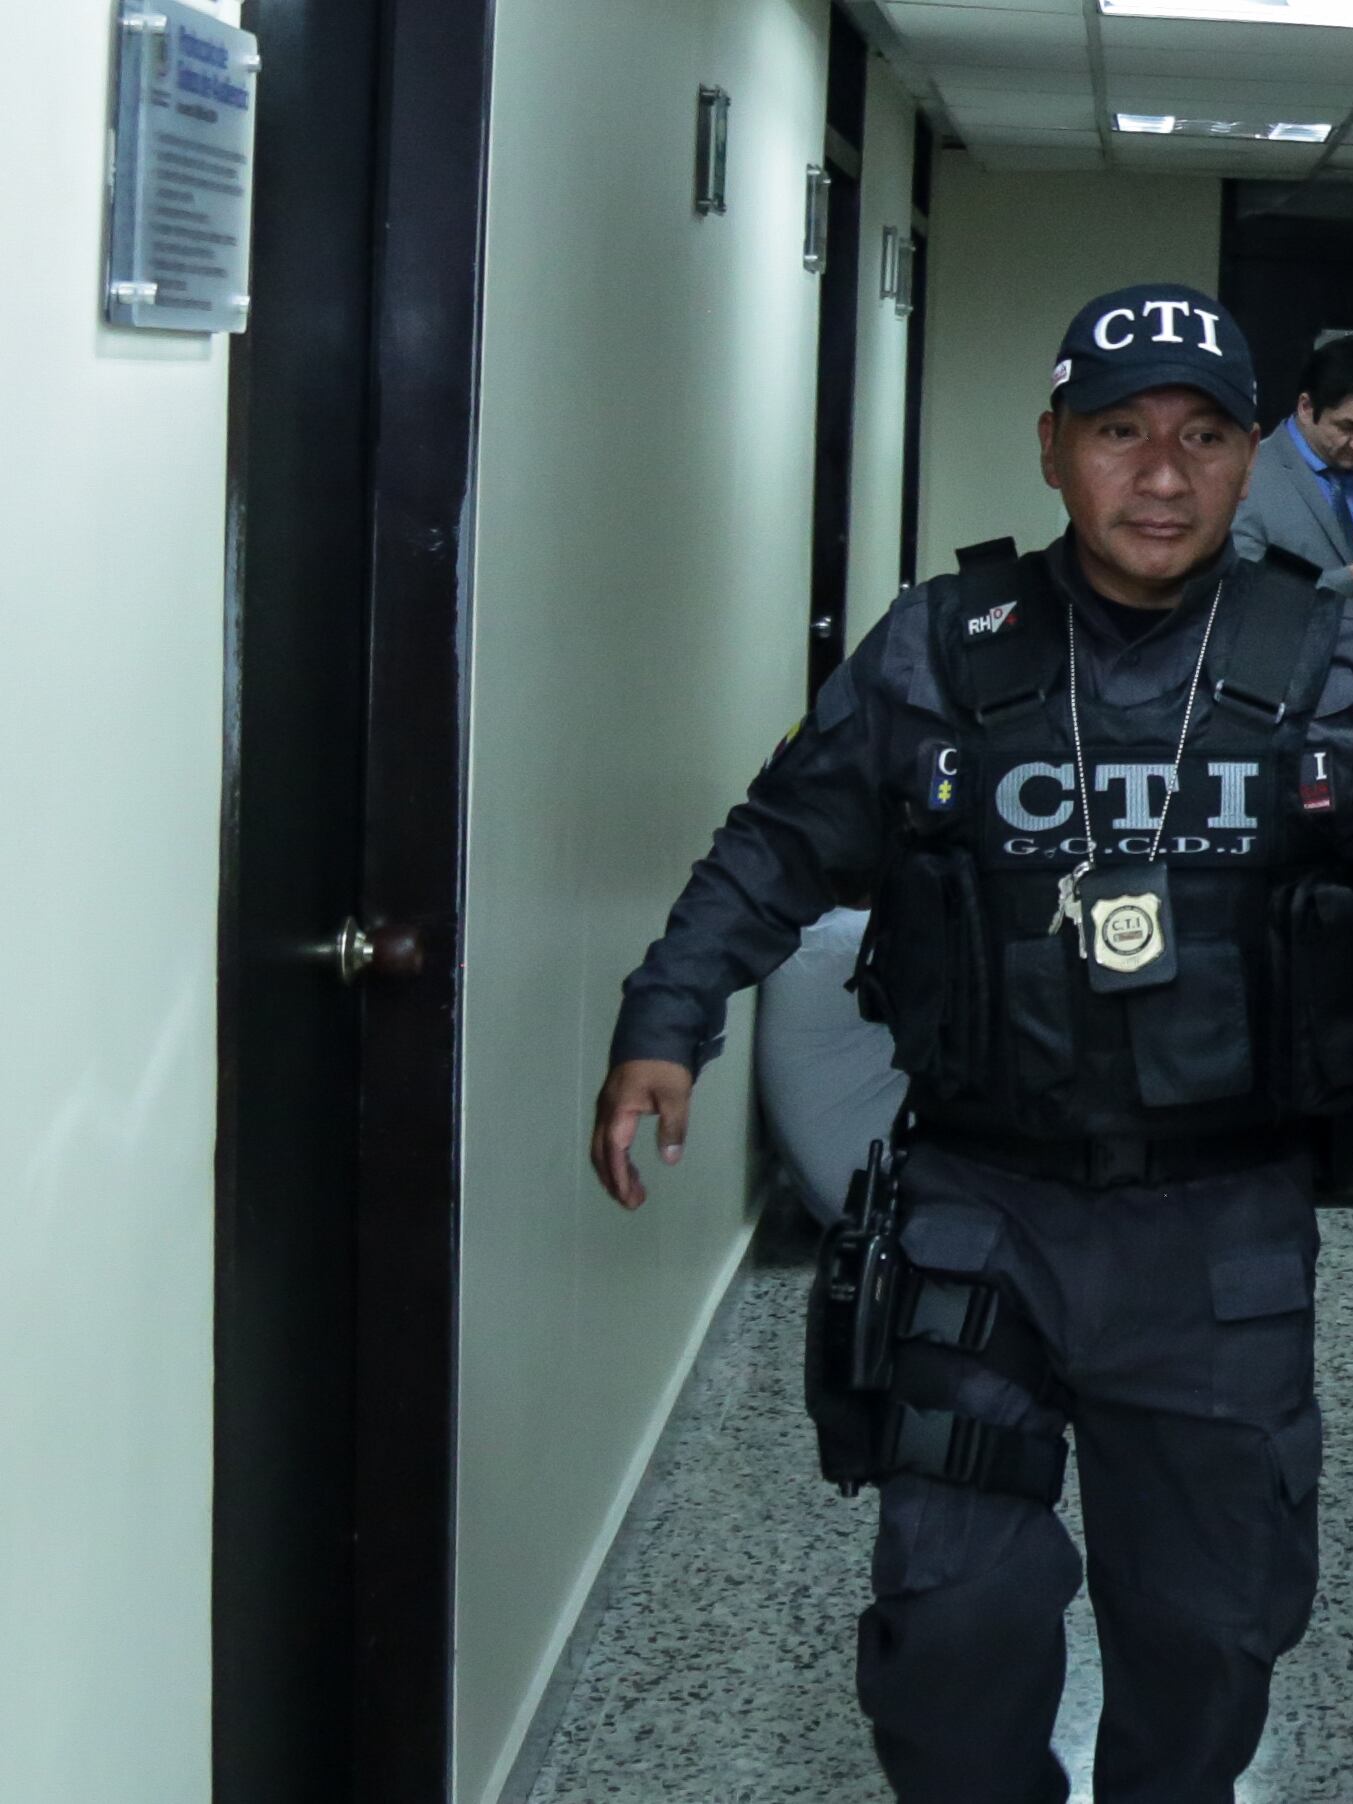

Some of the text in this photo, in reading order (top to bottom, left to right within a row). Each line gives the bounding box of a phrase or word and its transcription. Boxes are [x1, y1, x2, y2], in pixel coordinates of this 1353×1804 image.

[1094, 301, 1223, 357] CTI
[938, 748, 958, 776] C
[995, 761, 1258, 832] CTI
